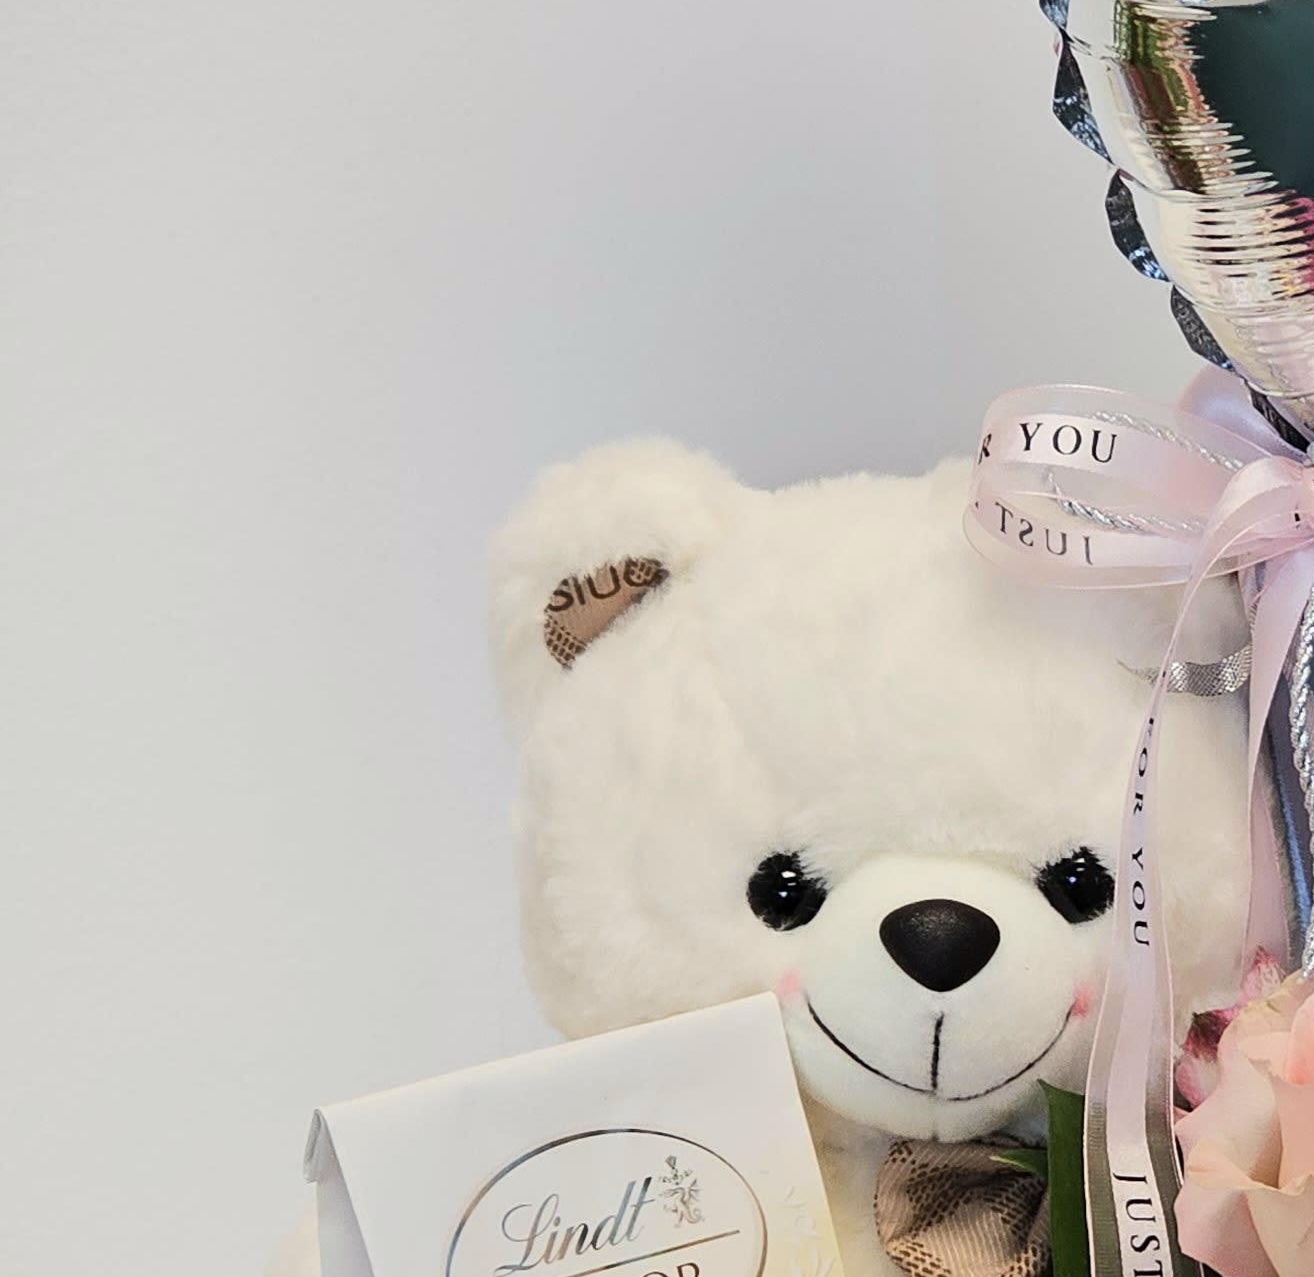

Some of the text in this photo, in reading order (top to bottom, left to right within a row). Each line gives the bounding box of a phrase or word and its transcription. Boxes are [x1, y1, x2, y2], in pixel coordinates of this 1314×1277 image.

[1019, 422, 1117, 463] YOU
[1131, 847, 1150, 946] YOU
[493, 1176, 655, 1277] Lindt
